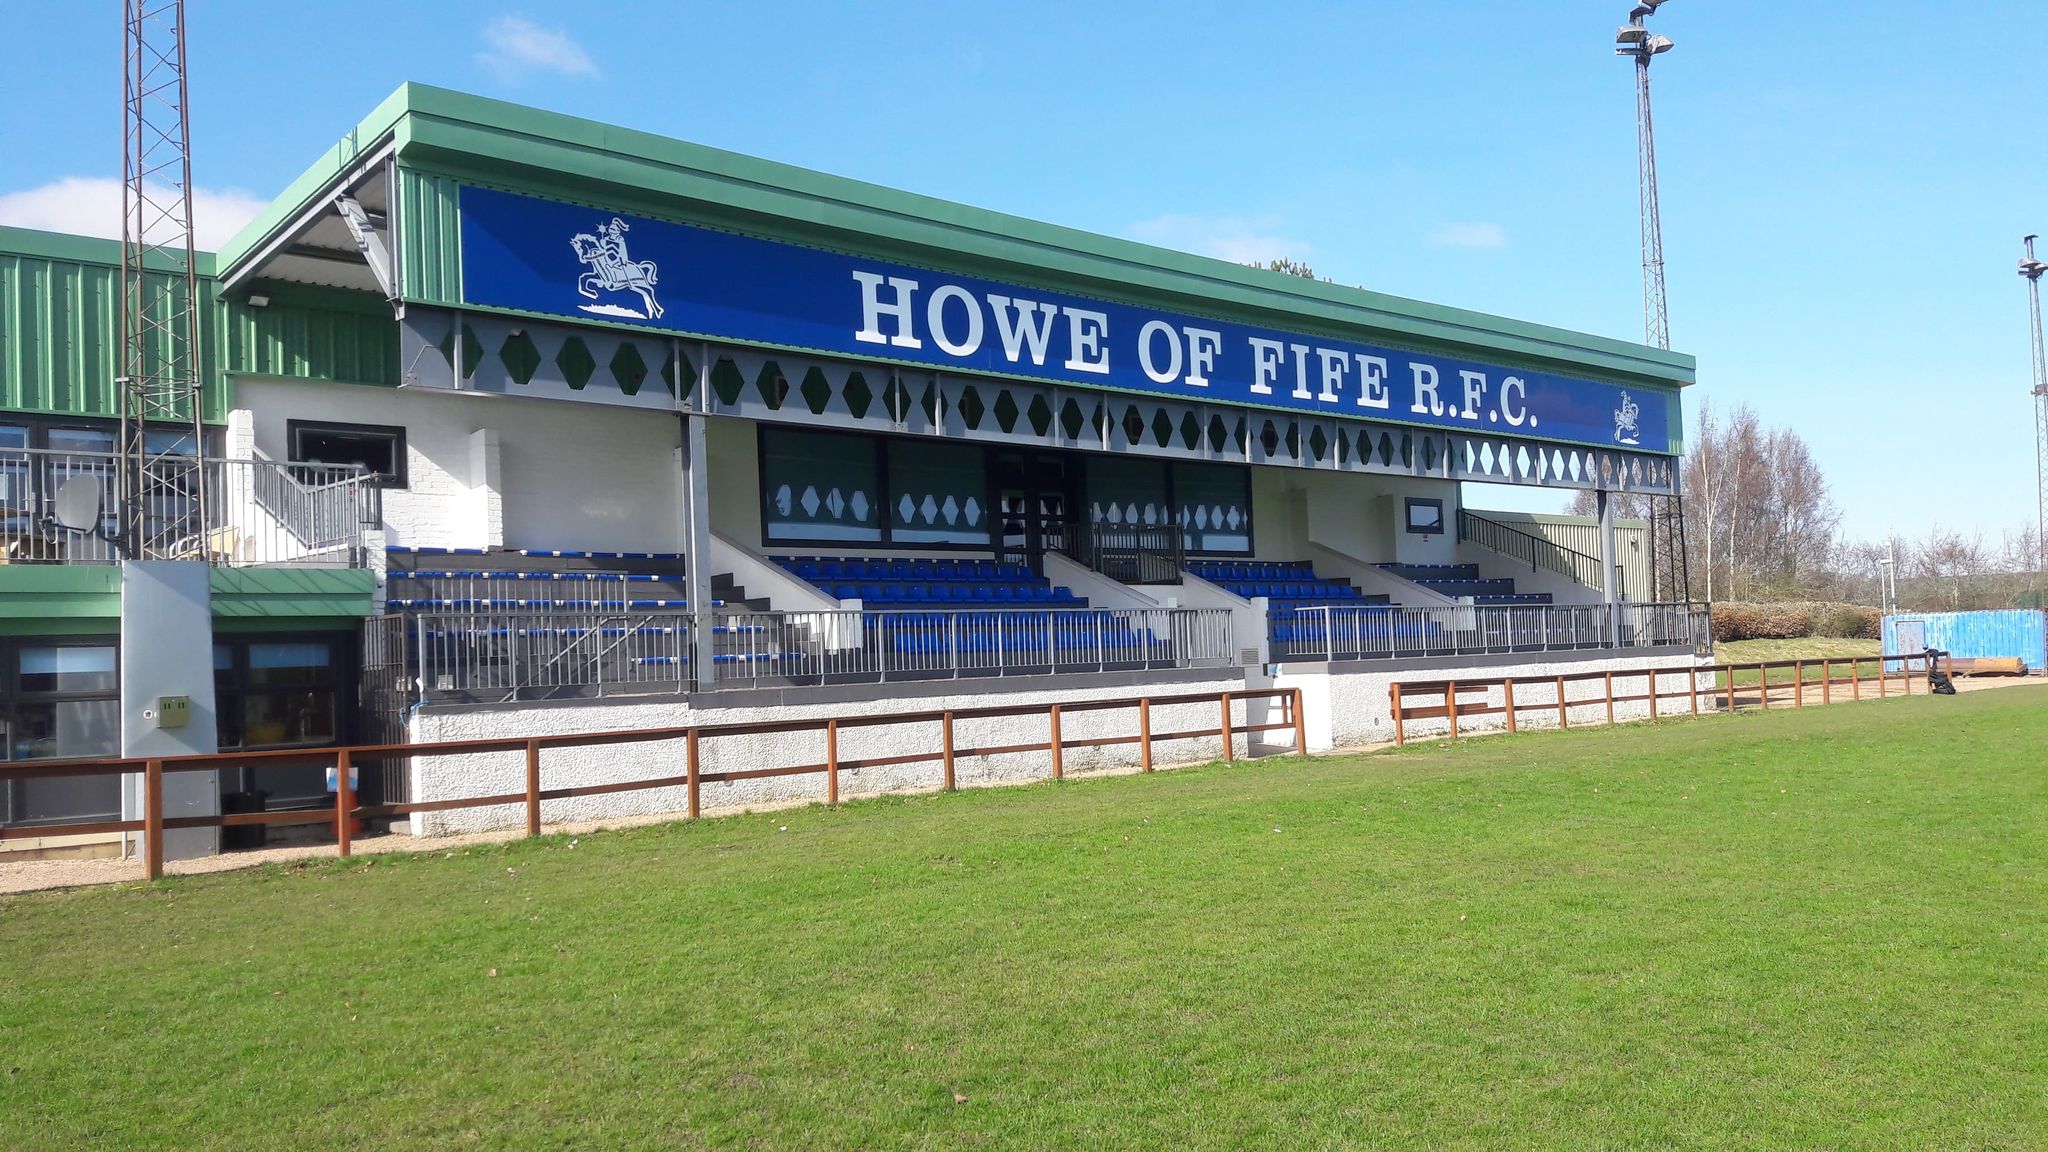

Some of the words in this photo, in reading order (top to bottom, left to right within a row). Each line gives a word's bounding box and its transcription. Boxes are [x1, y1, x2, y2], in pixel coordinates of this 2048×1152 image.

[852, 270, 1110, 375] HOWE
[1137, 320, 1222, 387] OF
[1248, 336, 1390, 410] FIFE
[1409, 361, 1538, 429] R.F.C.
